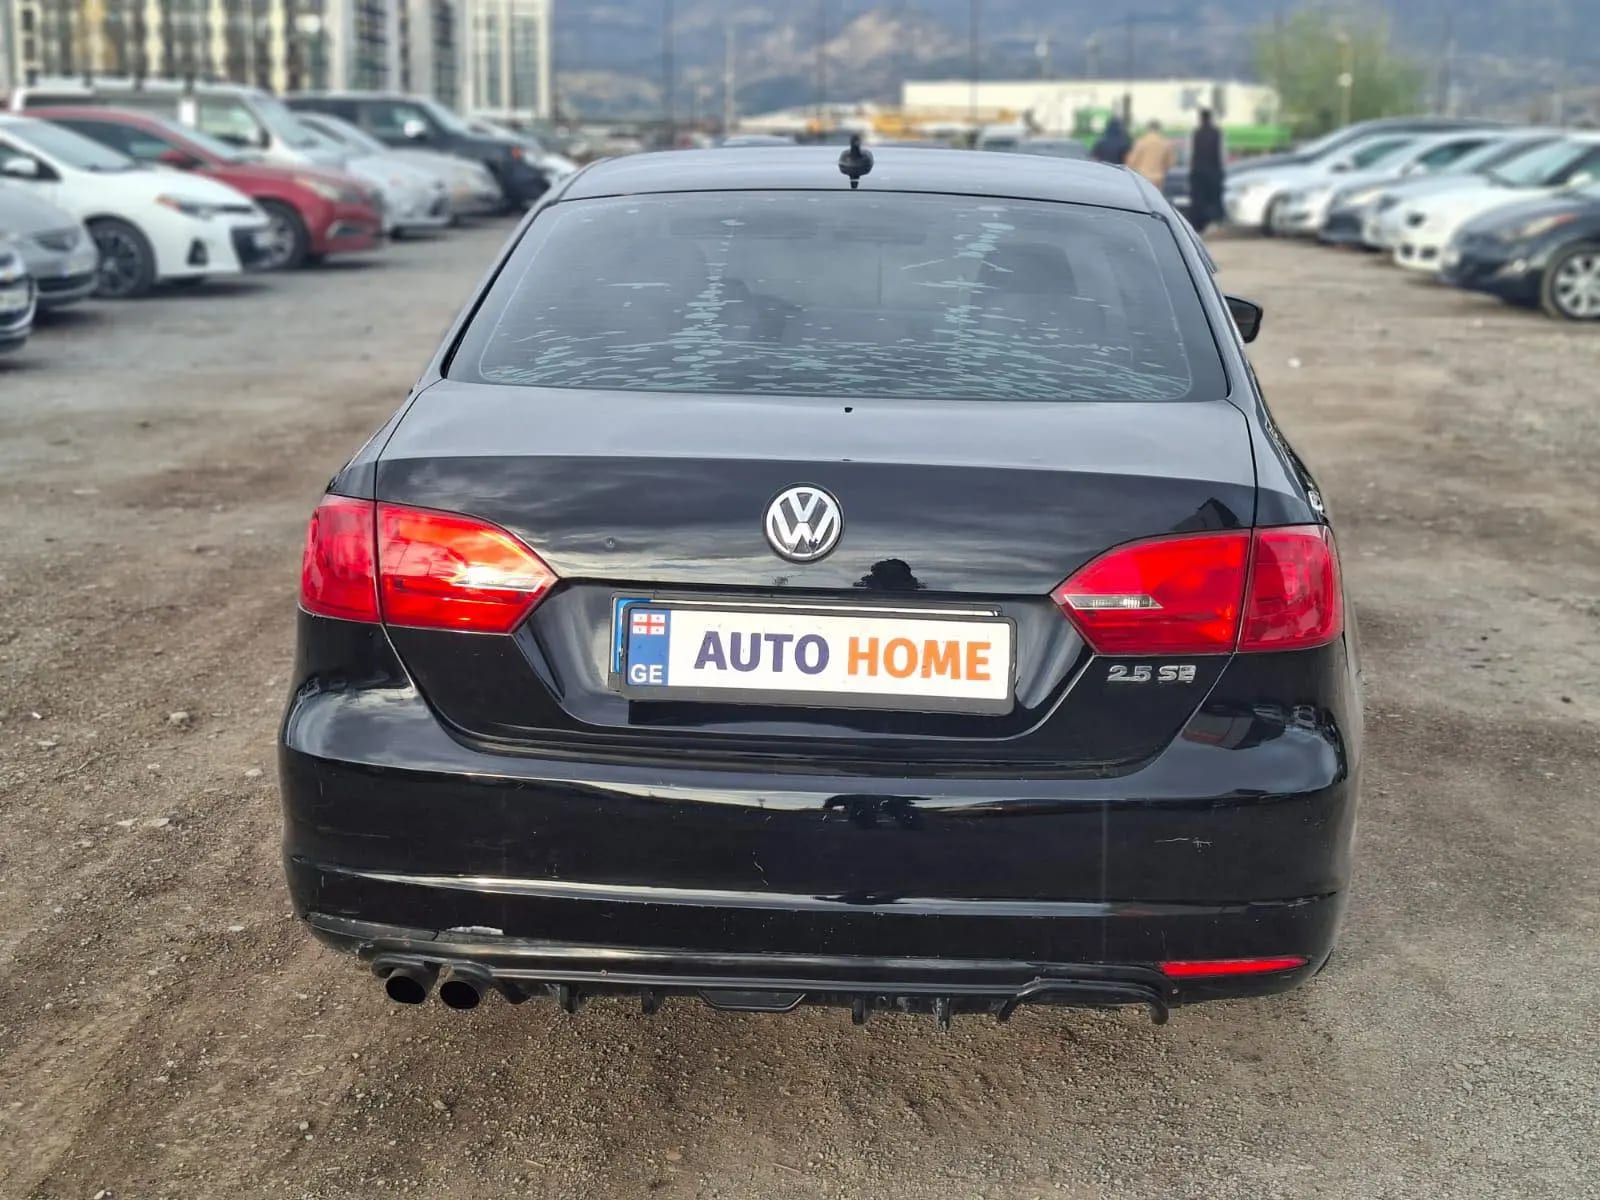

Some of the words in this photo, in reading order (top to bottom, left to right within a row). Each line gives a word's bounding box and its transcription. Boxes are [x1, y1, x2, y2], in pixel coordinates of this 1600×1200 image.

[694, 631, 830, 675] AUTO
[847, 637, 992, 681] HOME
[630, 664, 664, 684] GE
